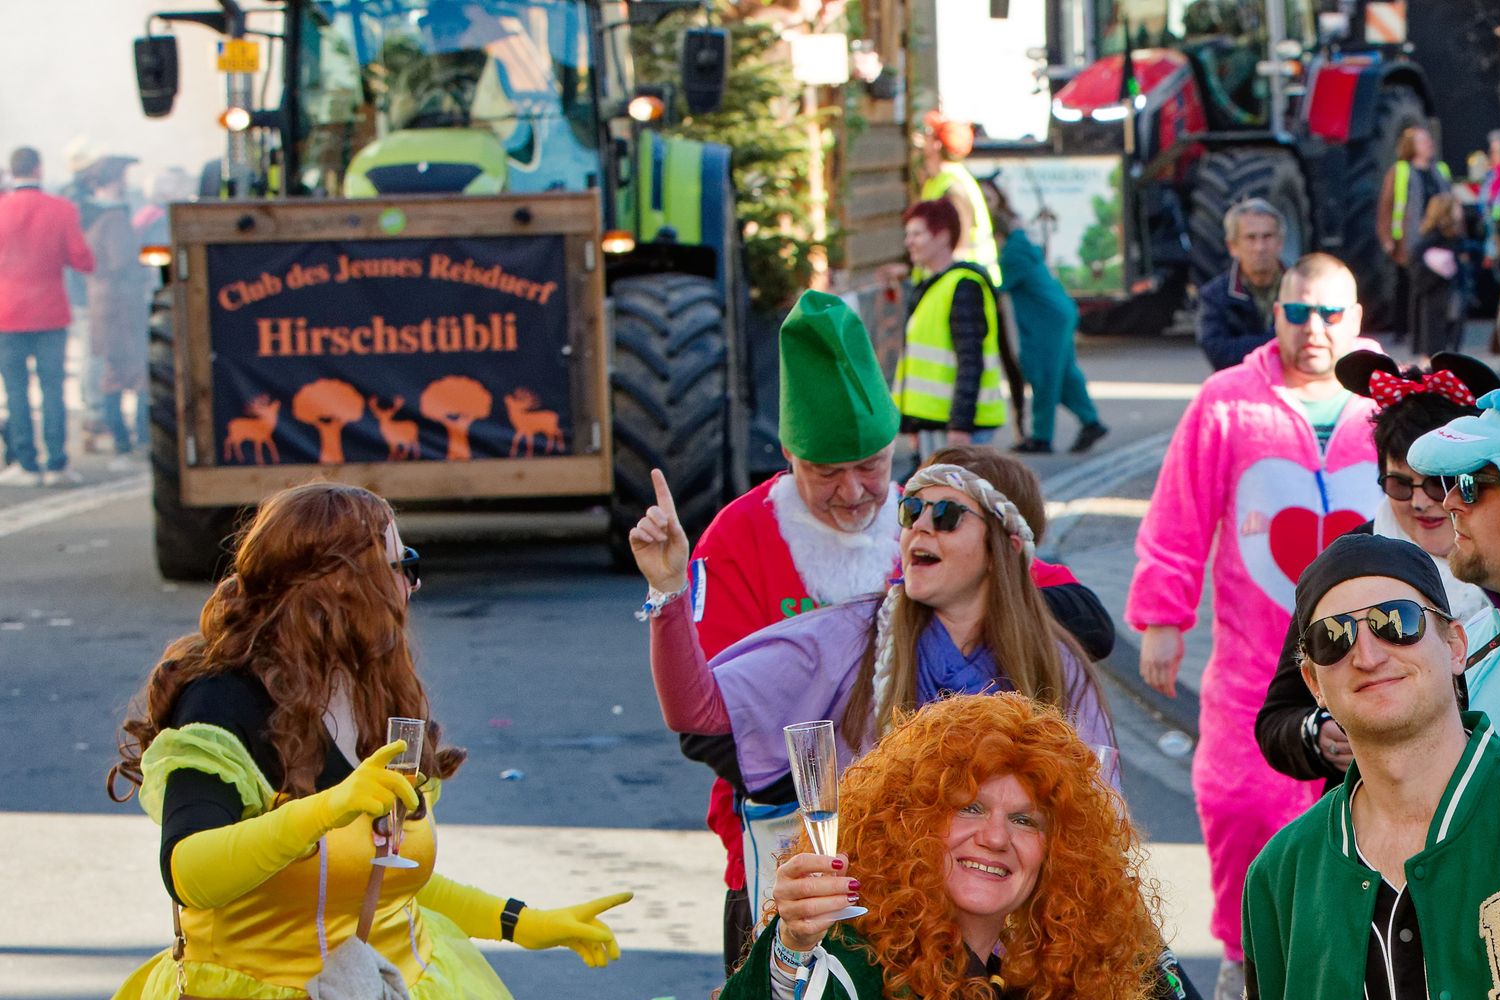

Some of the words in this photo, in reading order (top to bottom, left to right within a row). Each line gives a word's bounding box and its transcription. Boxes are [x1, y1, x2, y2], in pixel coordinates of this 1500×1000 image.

[218, 272, 282, 311] Club
[286, 262, 331, 289] des
[335, 253, 423, 283] Jeunes
[429, 253, 558, 304] Reisduerf
[257, 312, 518, 357] Hirschstübli
